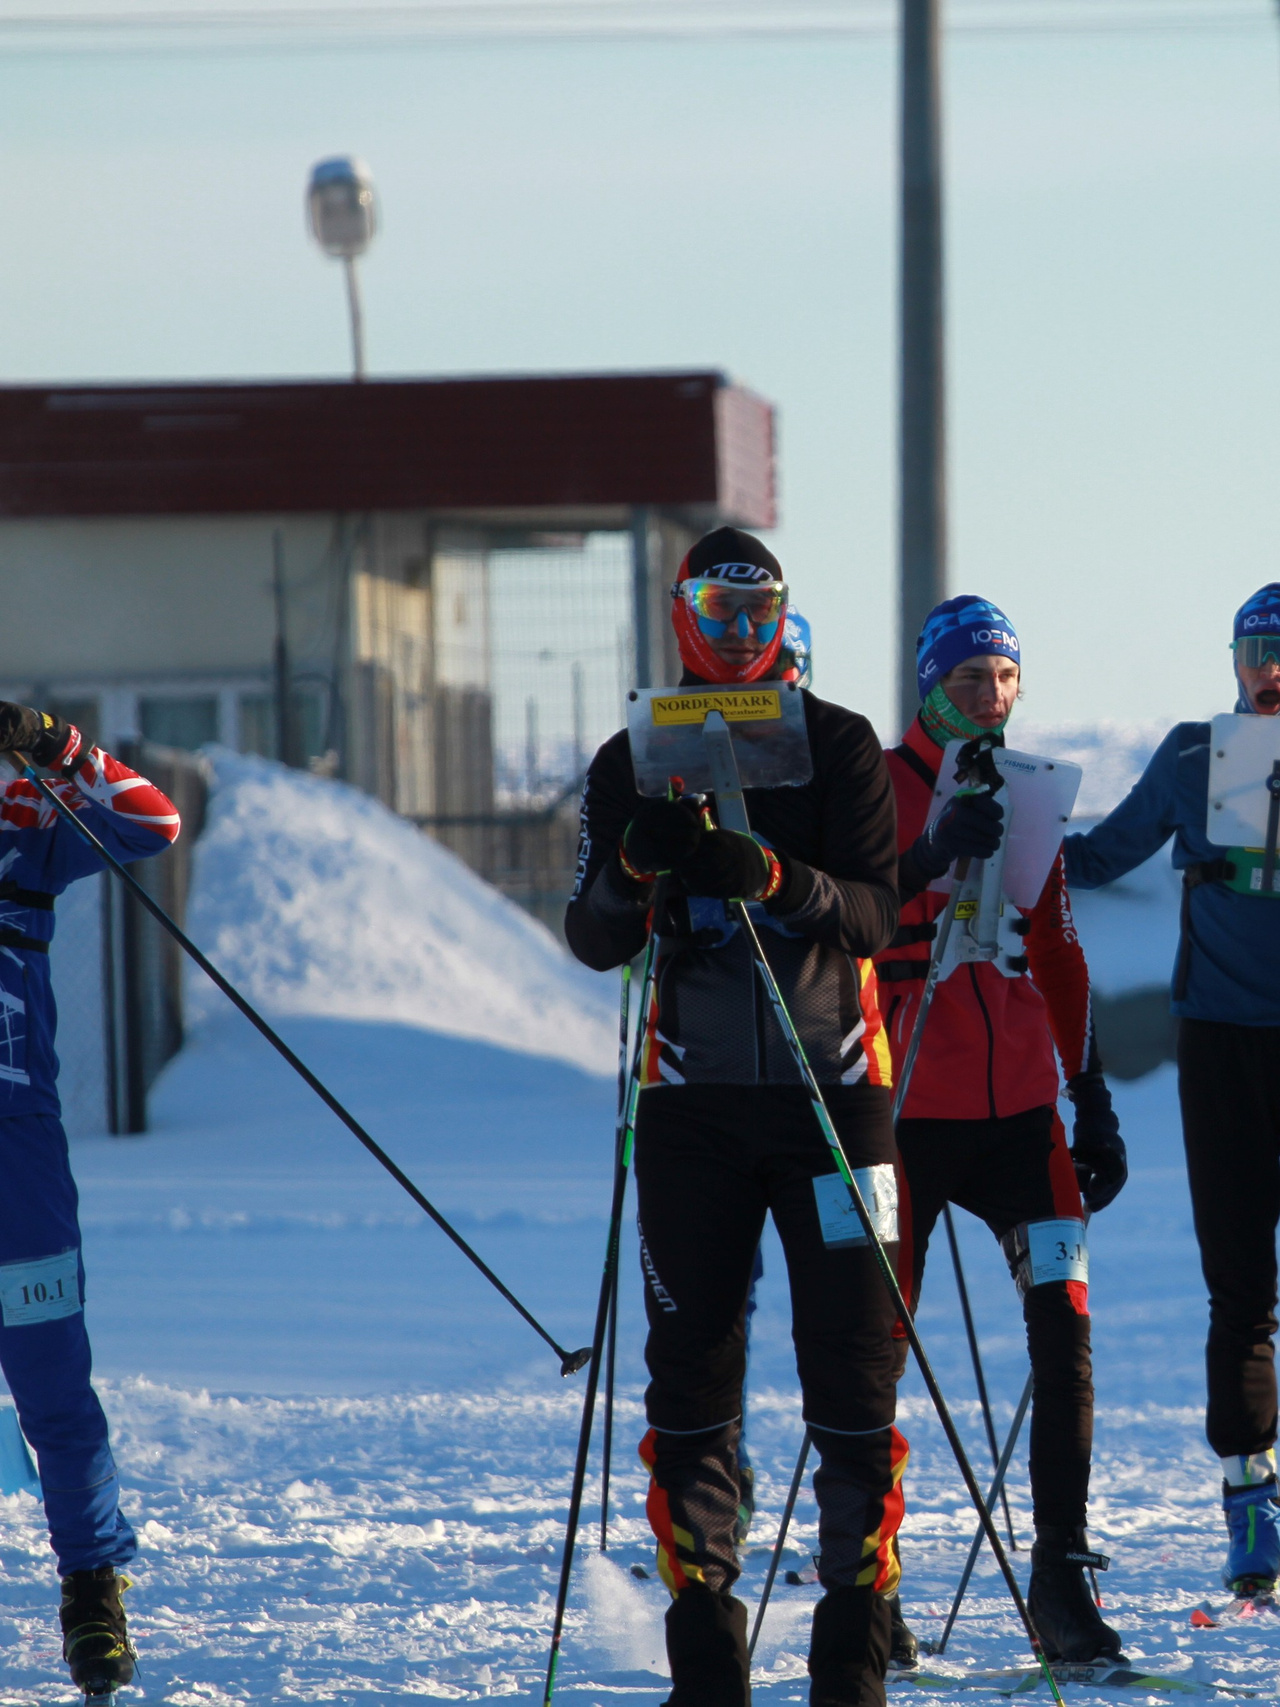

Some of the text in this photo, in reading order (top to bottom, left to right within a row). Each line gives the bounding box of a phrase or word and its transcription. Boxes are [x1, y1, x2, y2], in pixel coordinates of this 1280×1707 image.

[656, 694, 774, 712] NORDENMARK
[1003, 758, 1037, 772] FISHIAN
[1054, 1240, 1083, 1262] 3.1
[20, 1277, 65, 1305] 10.1
